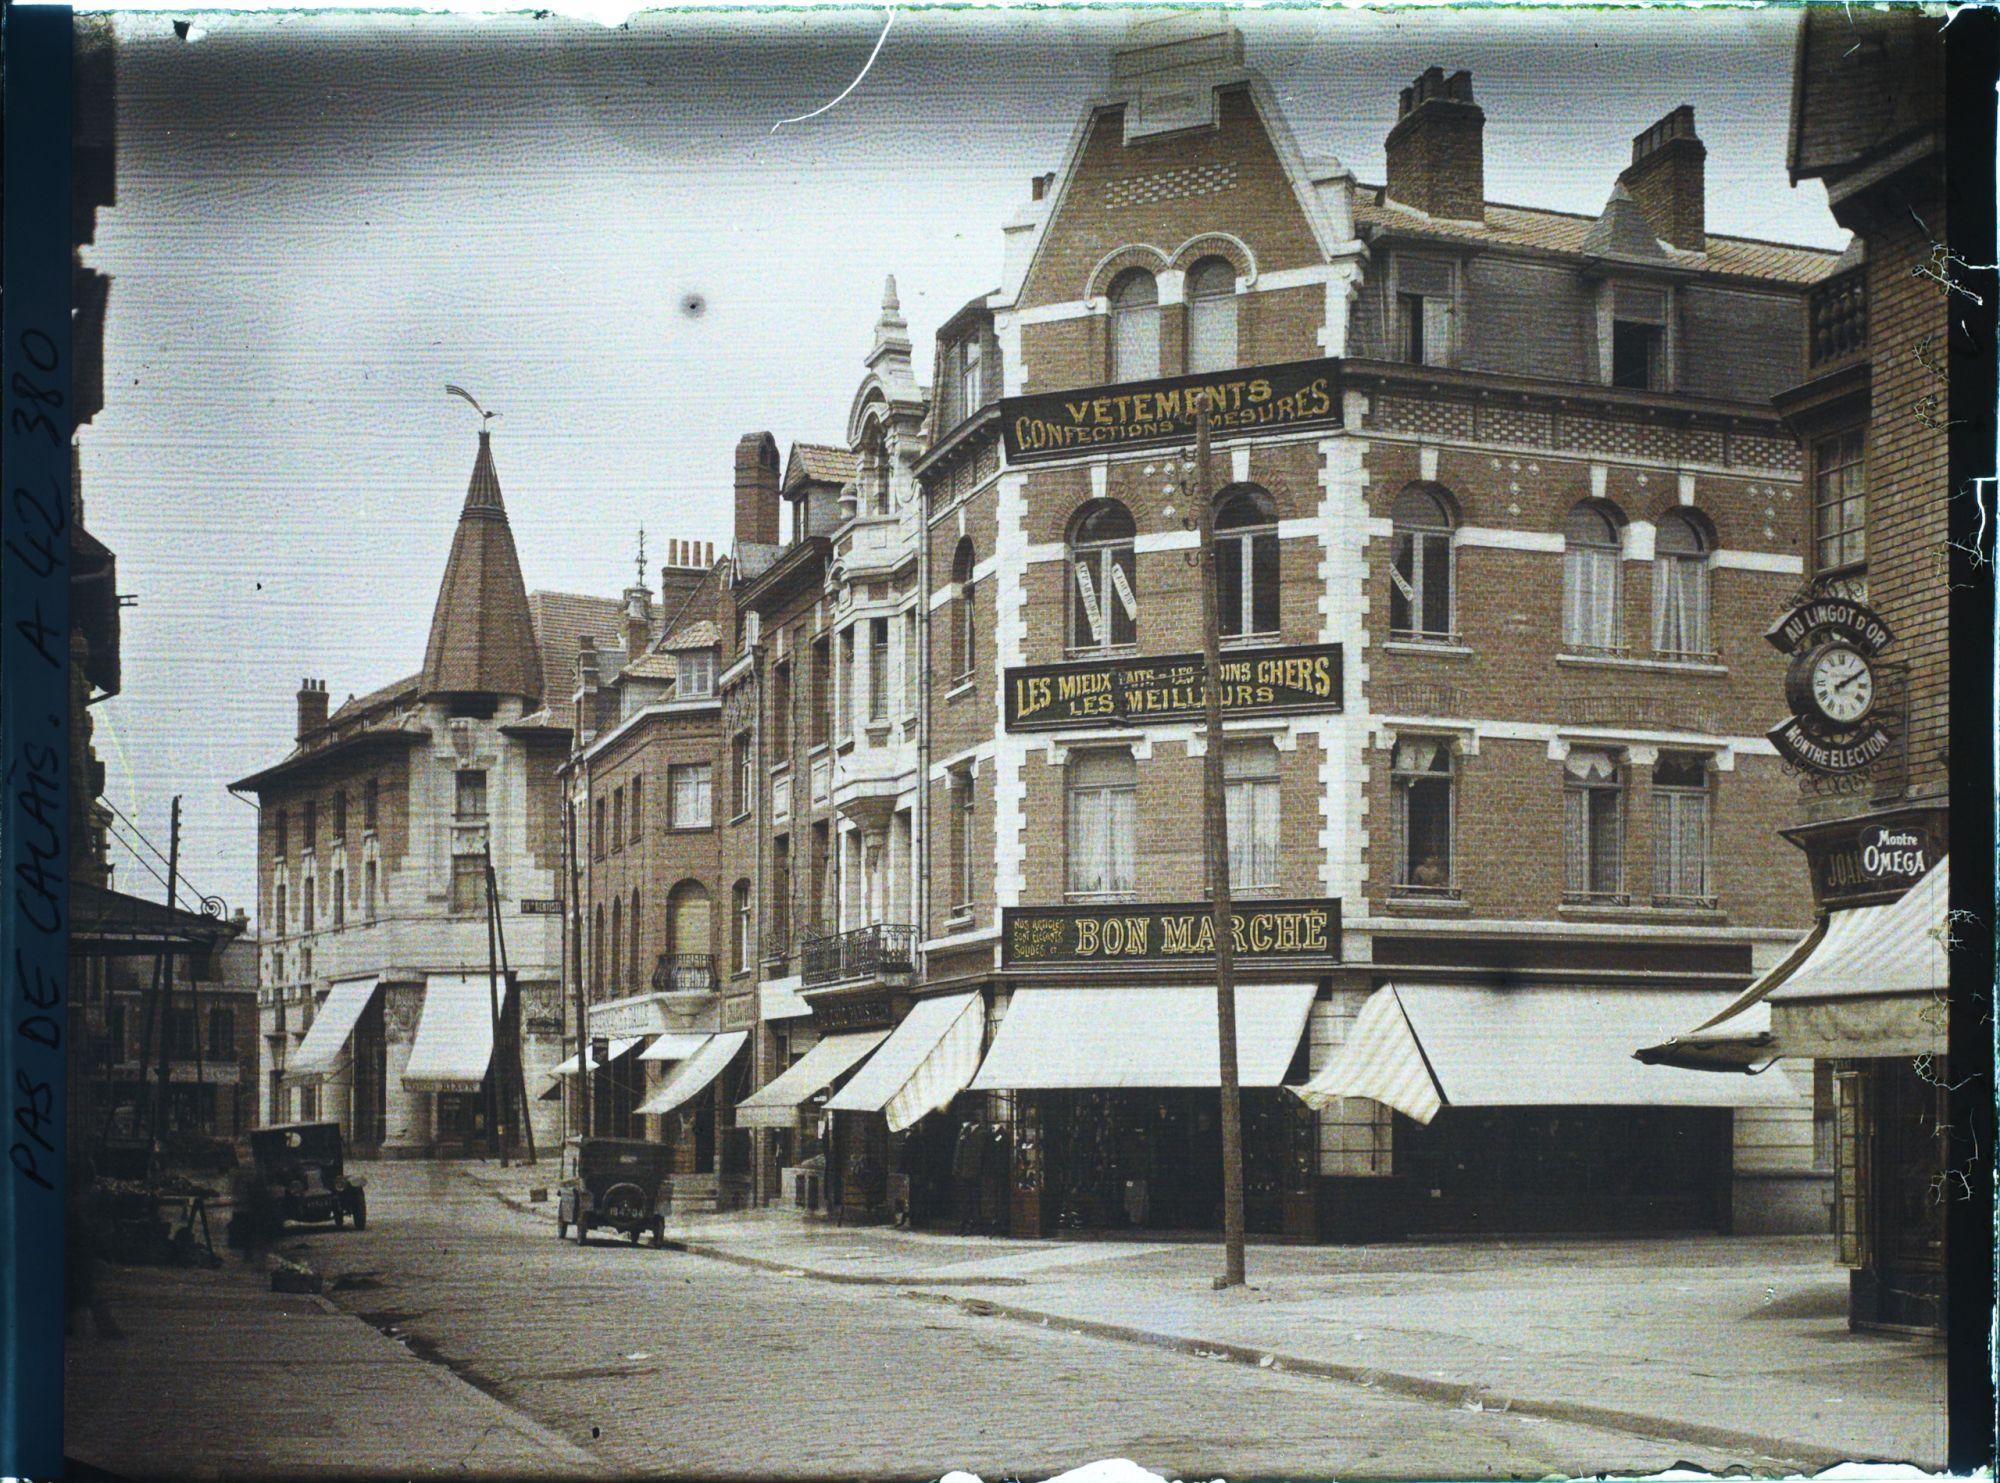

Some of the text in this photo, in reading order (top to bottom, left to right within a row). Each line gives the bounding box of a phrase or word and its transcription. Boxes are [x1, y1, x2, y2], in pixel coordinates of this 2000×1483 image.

[12, 328, 64, 448] 380
[1014, 378, 1330, 451] CONFECTIONS MESURES
[6, 474, 65, 579] 42
[16, 598, 61, 670] A
[1785, 604, 1887, 648] AU LINGOT D'OR
[1016, 677, 1051, 719] LES
[1058, 672, 1112, 701] MIEUX
[1171, 666, 1195, 685] LES
[1257, 656, 1331, 698] CHERS
[1069, 693, 1115, 716] LES
[1785, 723, 1890, 769] MONTRE ELECTION
[1864, 845, 1926, 876] OMEGA
[1013, 944, 1046, 958] SOLIDES
[1014, 918, 1065, 931] NOS ARTICLES
[1075, 908, 1328, 956] BON MARCHÉ
[16, 948, 60, 1050] DE
[9, 1069, 54, 1191] PAS
